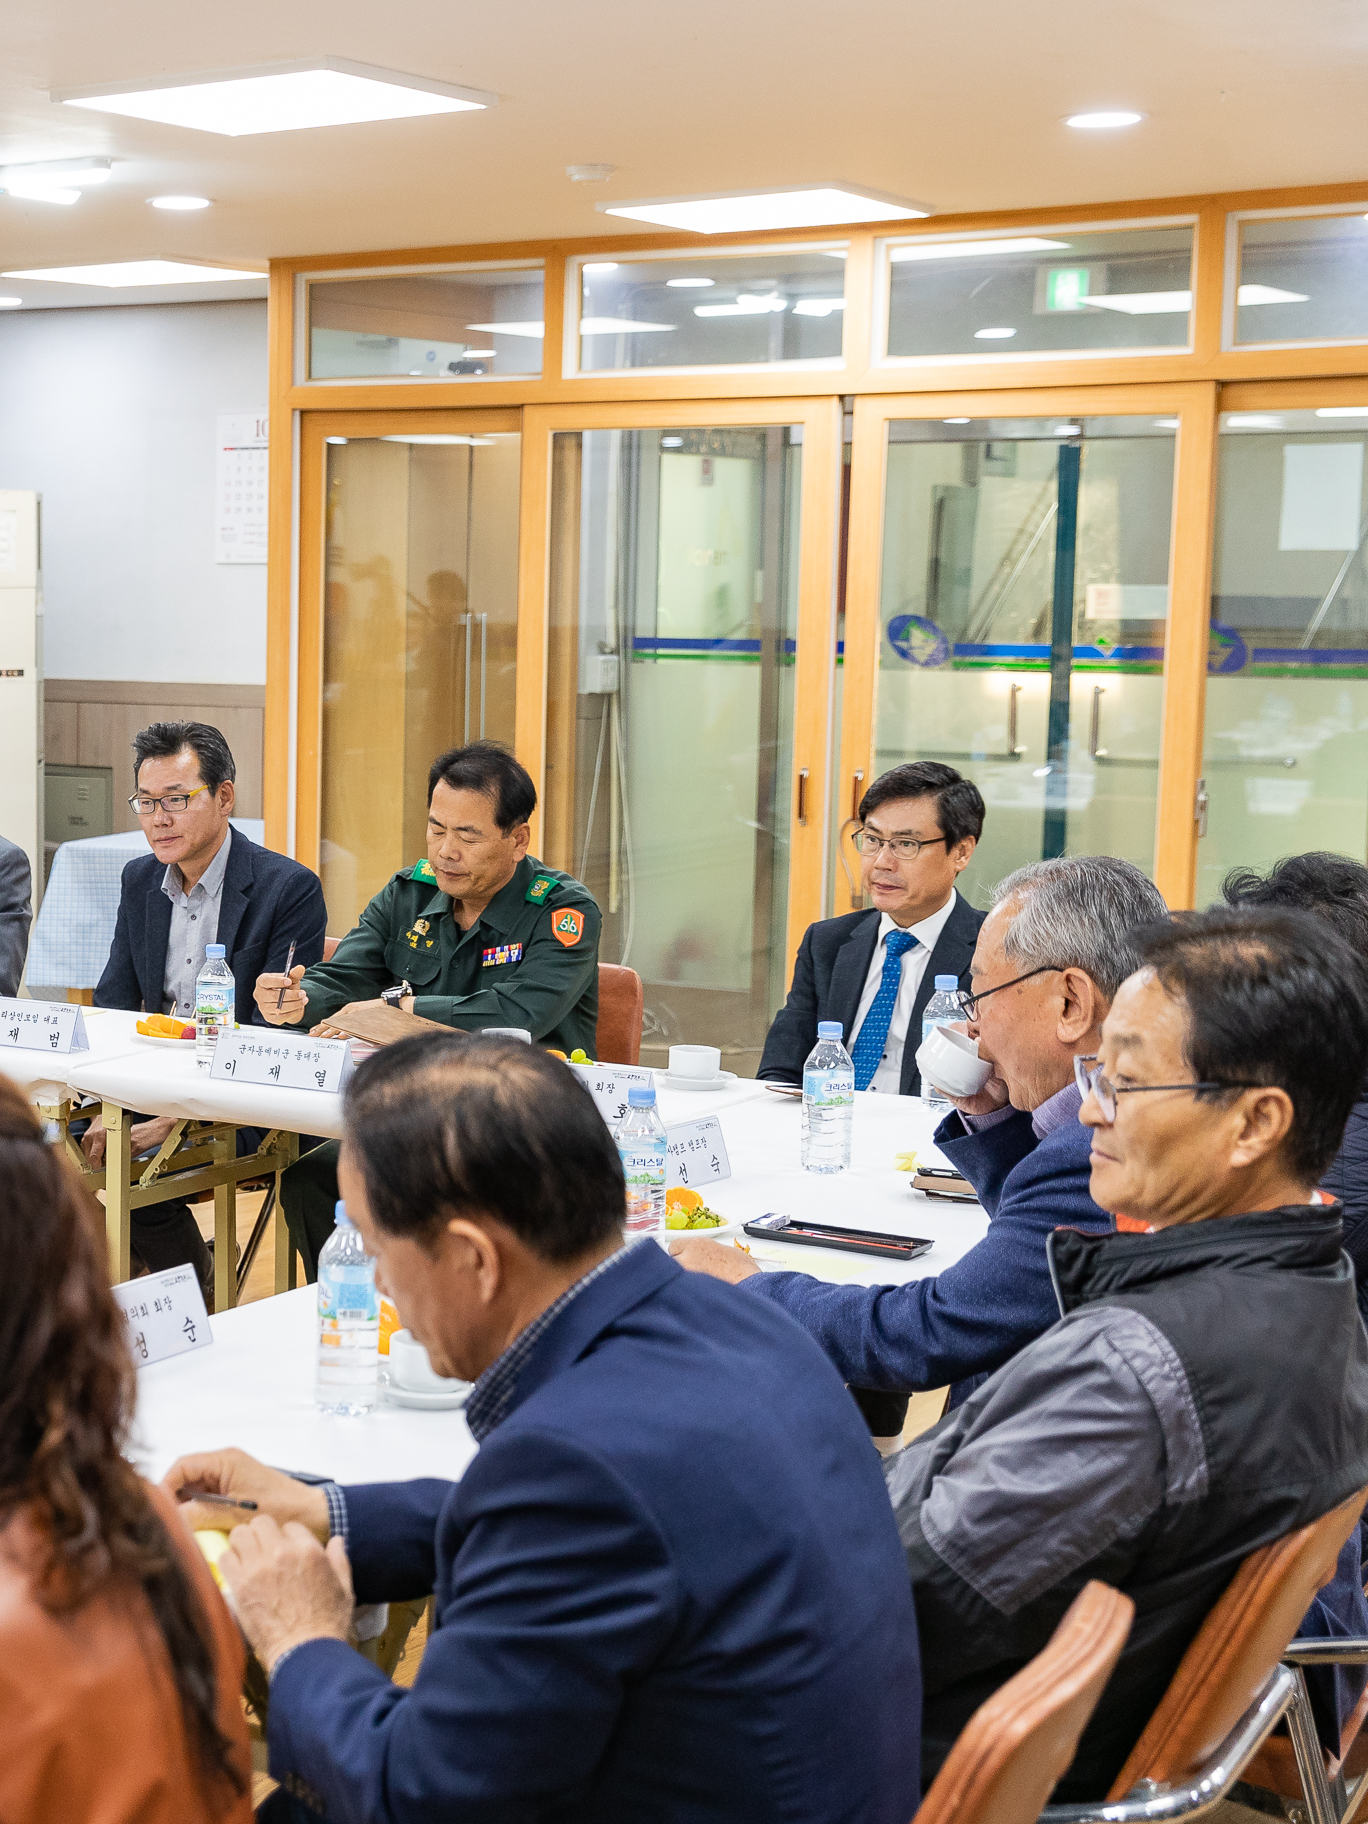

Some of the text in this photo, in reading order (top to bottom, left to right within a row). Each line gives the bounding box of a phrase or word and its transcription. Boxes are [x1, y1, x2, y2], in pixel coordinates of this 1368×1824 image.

[43, 1015, 59, 1025] 대표
[238, 1044, 321, 1063] 군자동예비군 동대장
[595, 1082, 616, 1094] 회장
[824, 1082, 853, 1091] 크리스탈
[626, 1157, 664, 1168] 크리스탈
[153, 1296, 173, 1313] 회장
